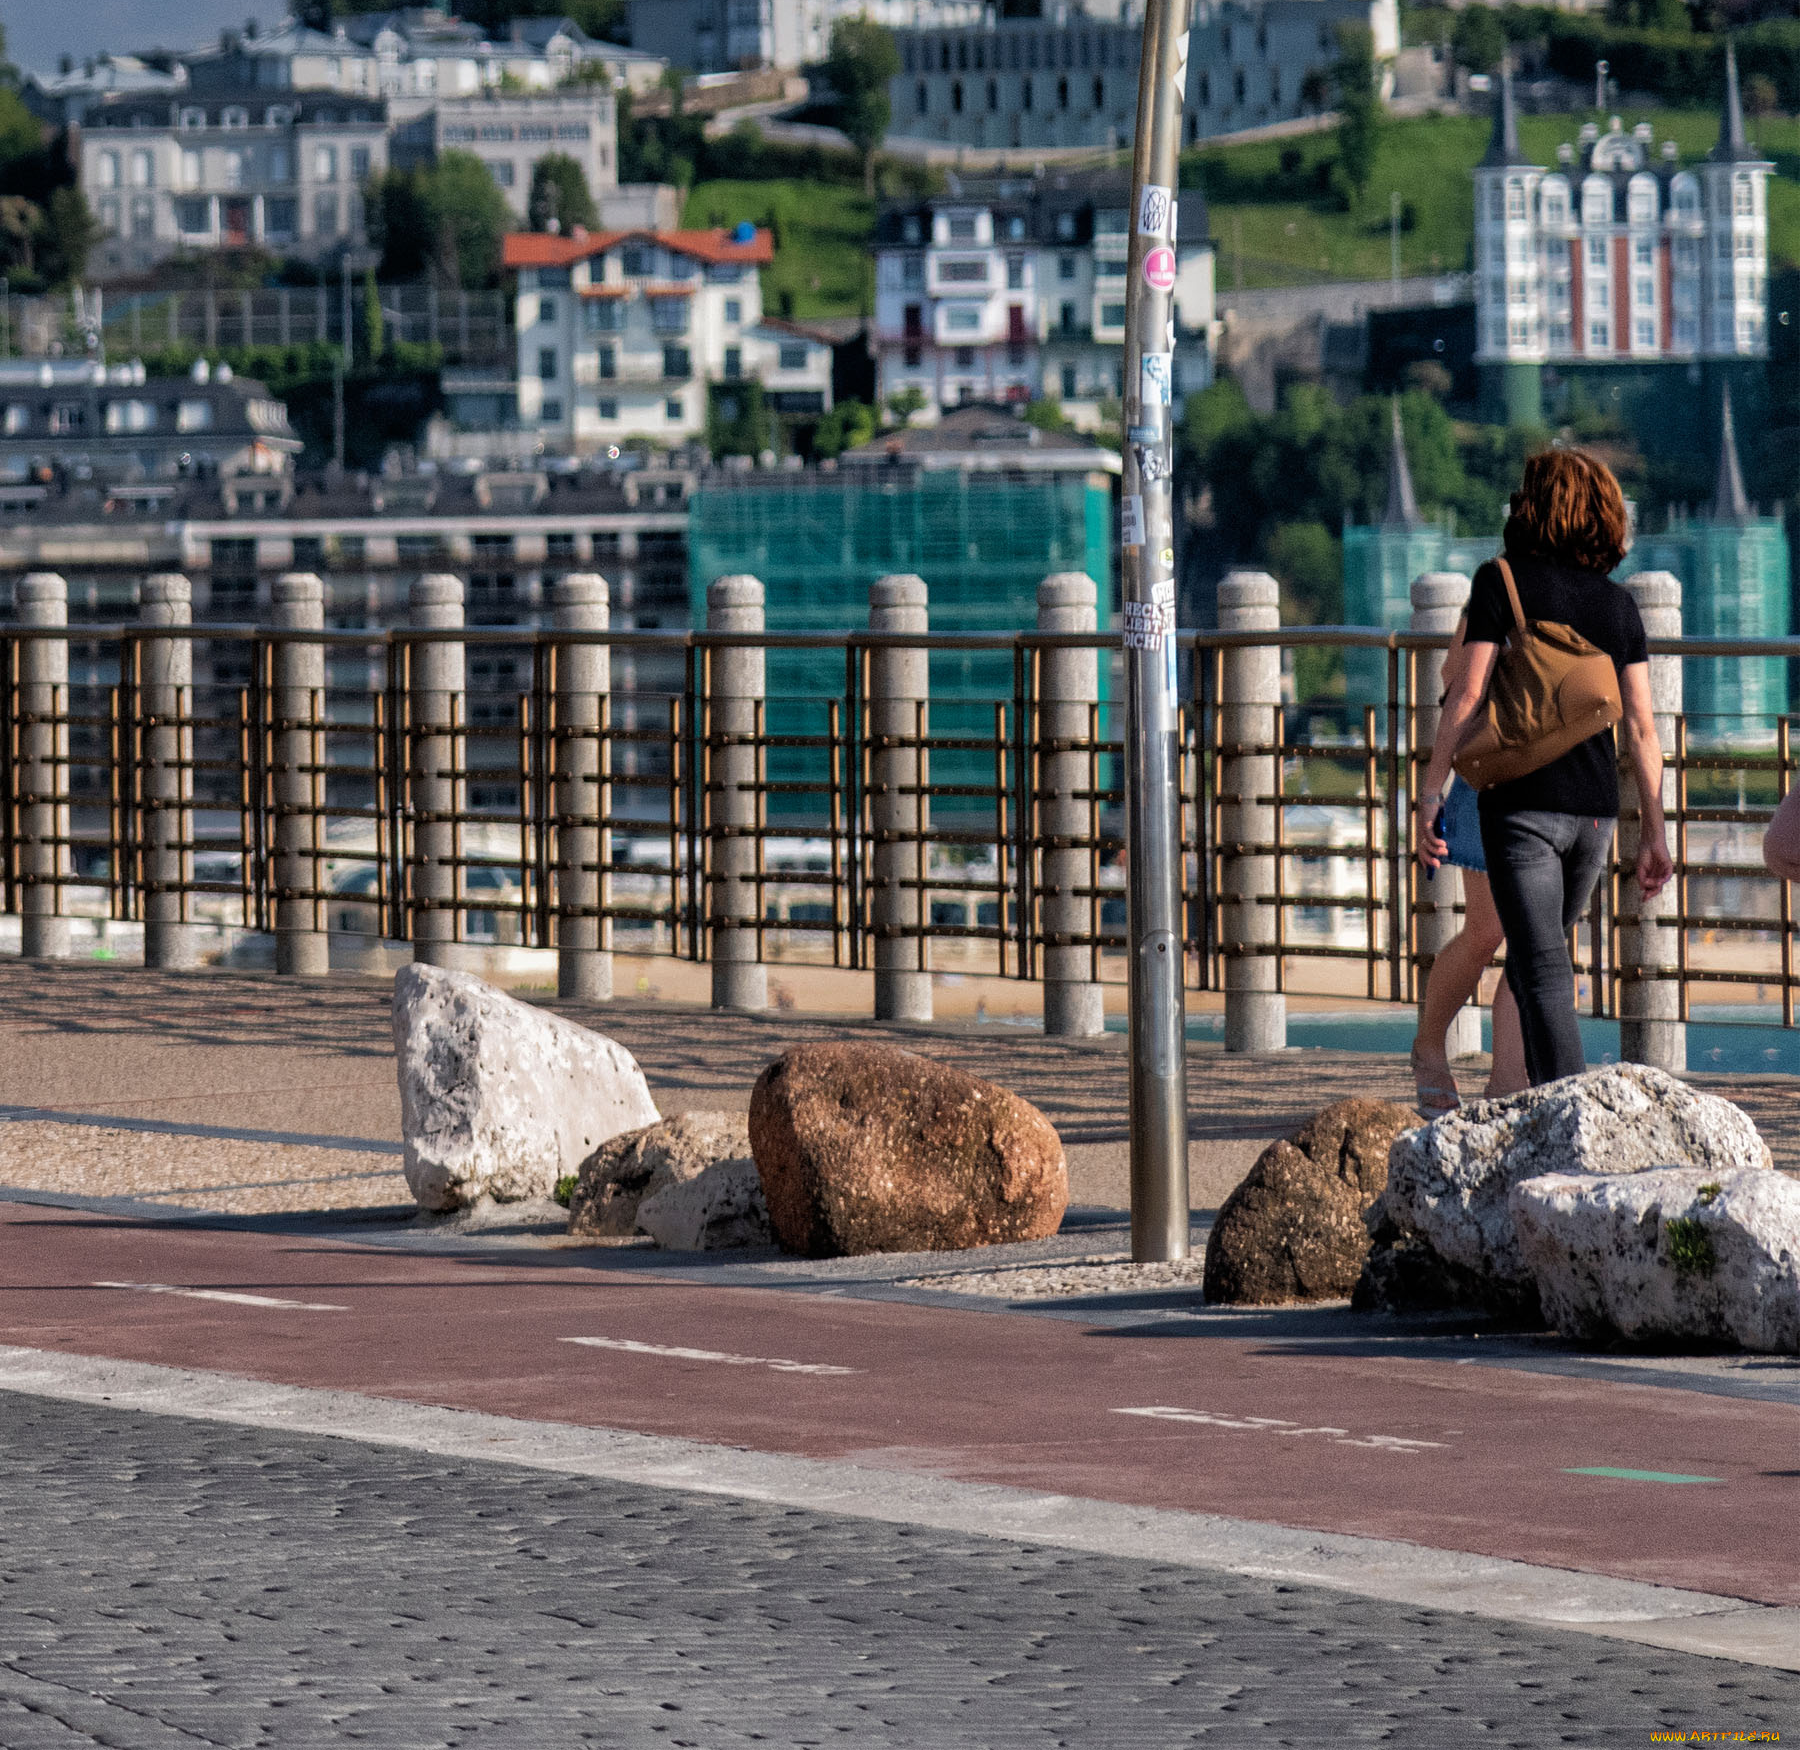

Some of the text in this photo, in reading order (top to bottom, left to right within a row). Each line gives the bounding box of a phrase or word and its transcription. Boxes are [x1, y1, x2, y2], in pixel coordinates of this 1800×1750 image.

[1125, 602, 1161, 619] HECK
[1125, 617, 1161, 633] LIEBT
[1124, 632, 1160, 650] DICH!
